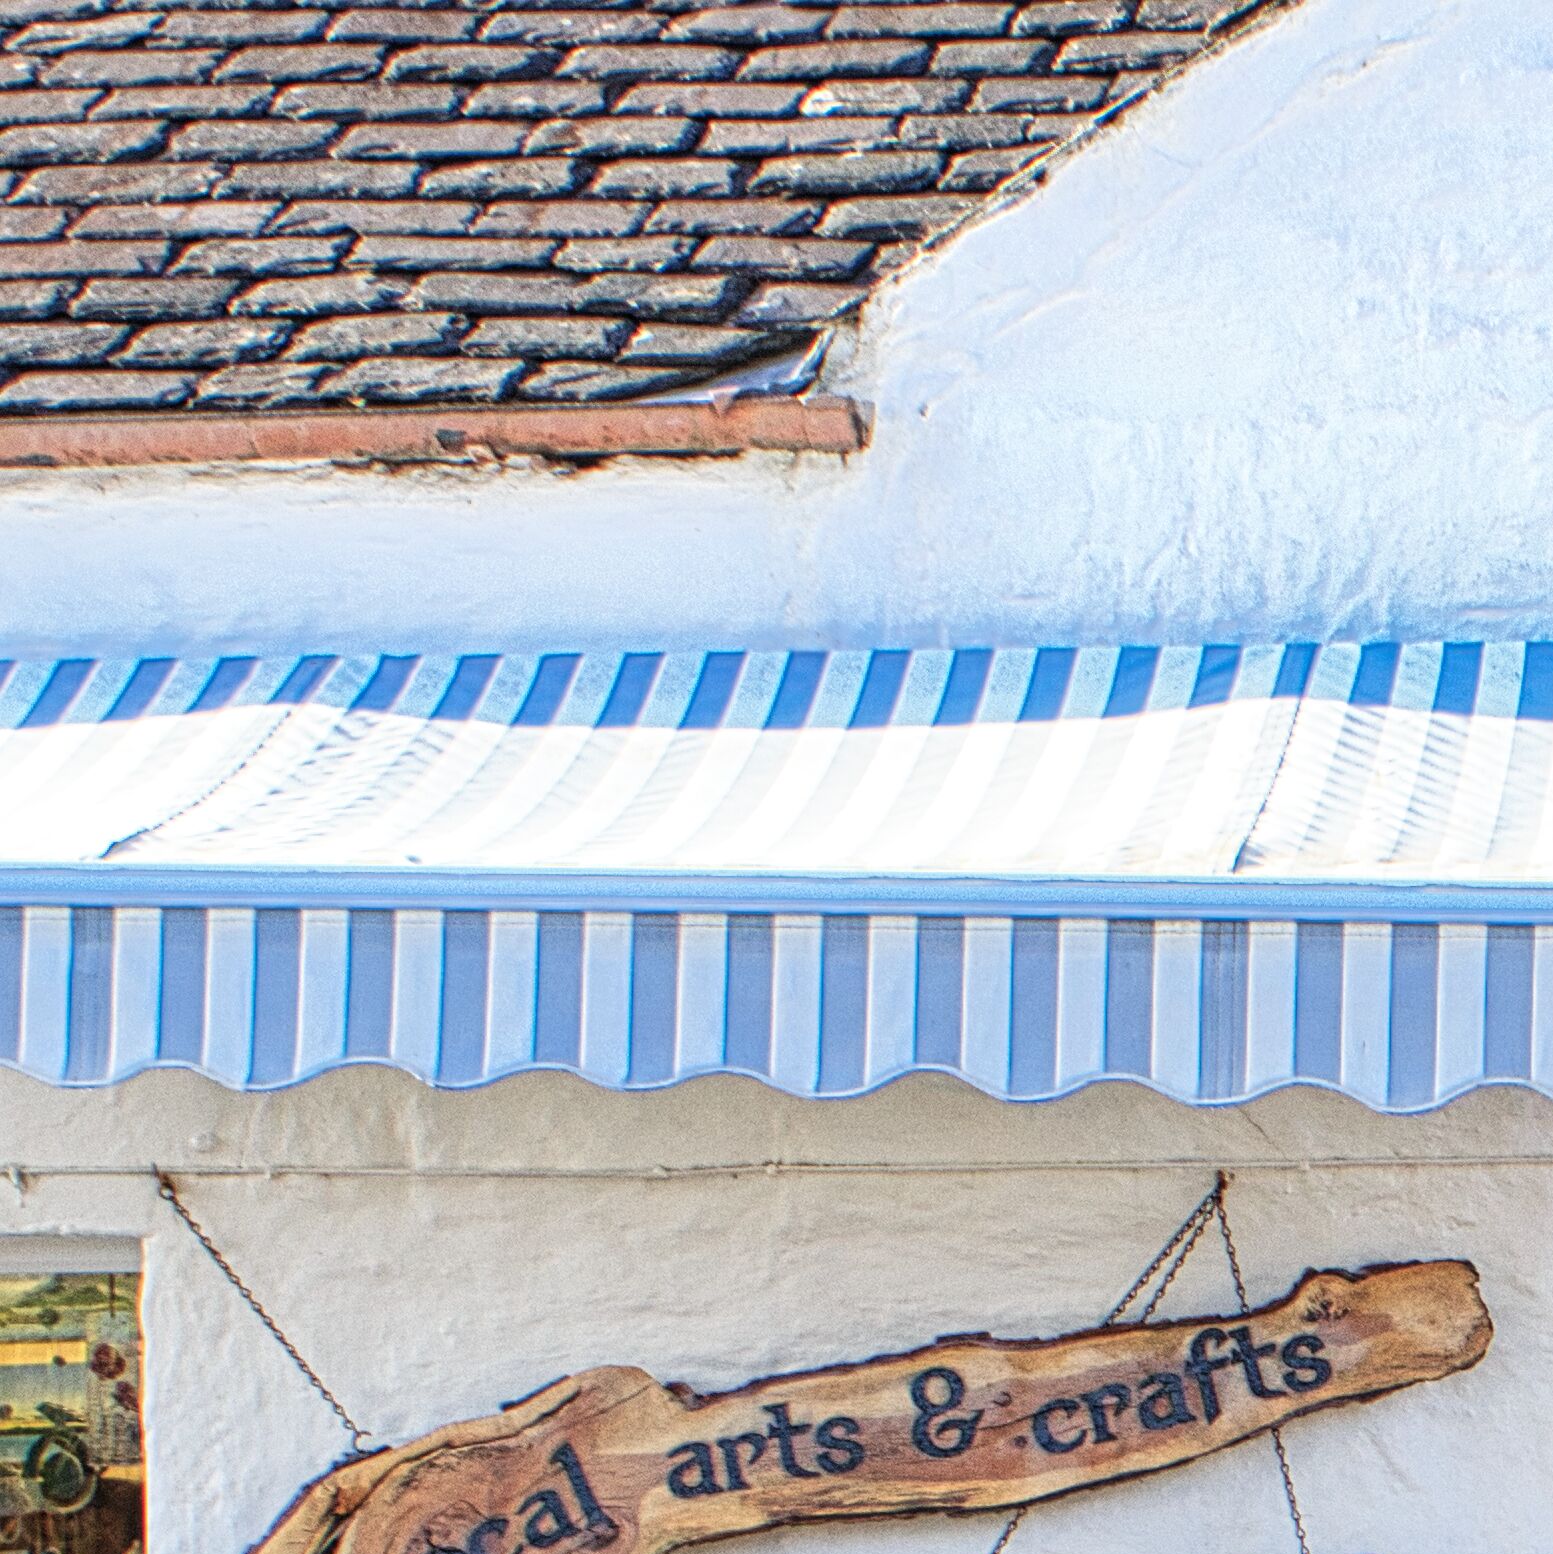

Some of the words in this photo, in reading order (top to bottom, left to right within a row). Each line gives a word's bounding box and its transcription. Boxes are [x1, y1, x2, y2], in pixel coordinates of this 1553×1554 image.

[666, 1401, 866, 1499] arts
[911, 1366, 982, 1458] &
[1028, 1327, 1331, 1454] crafts
